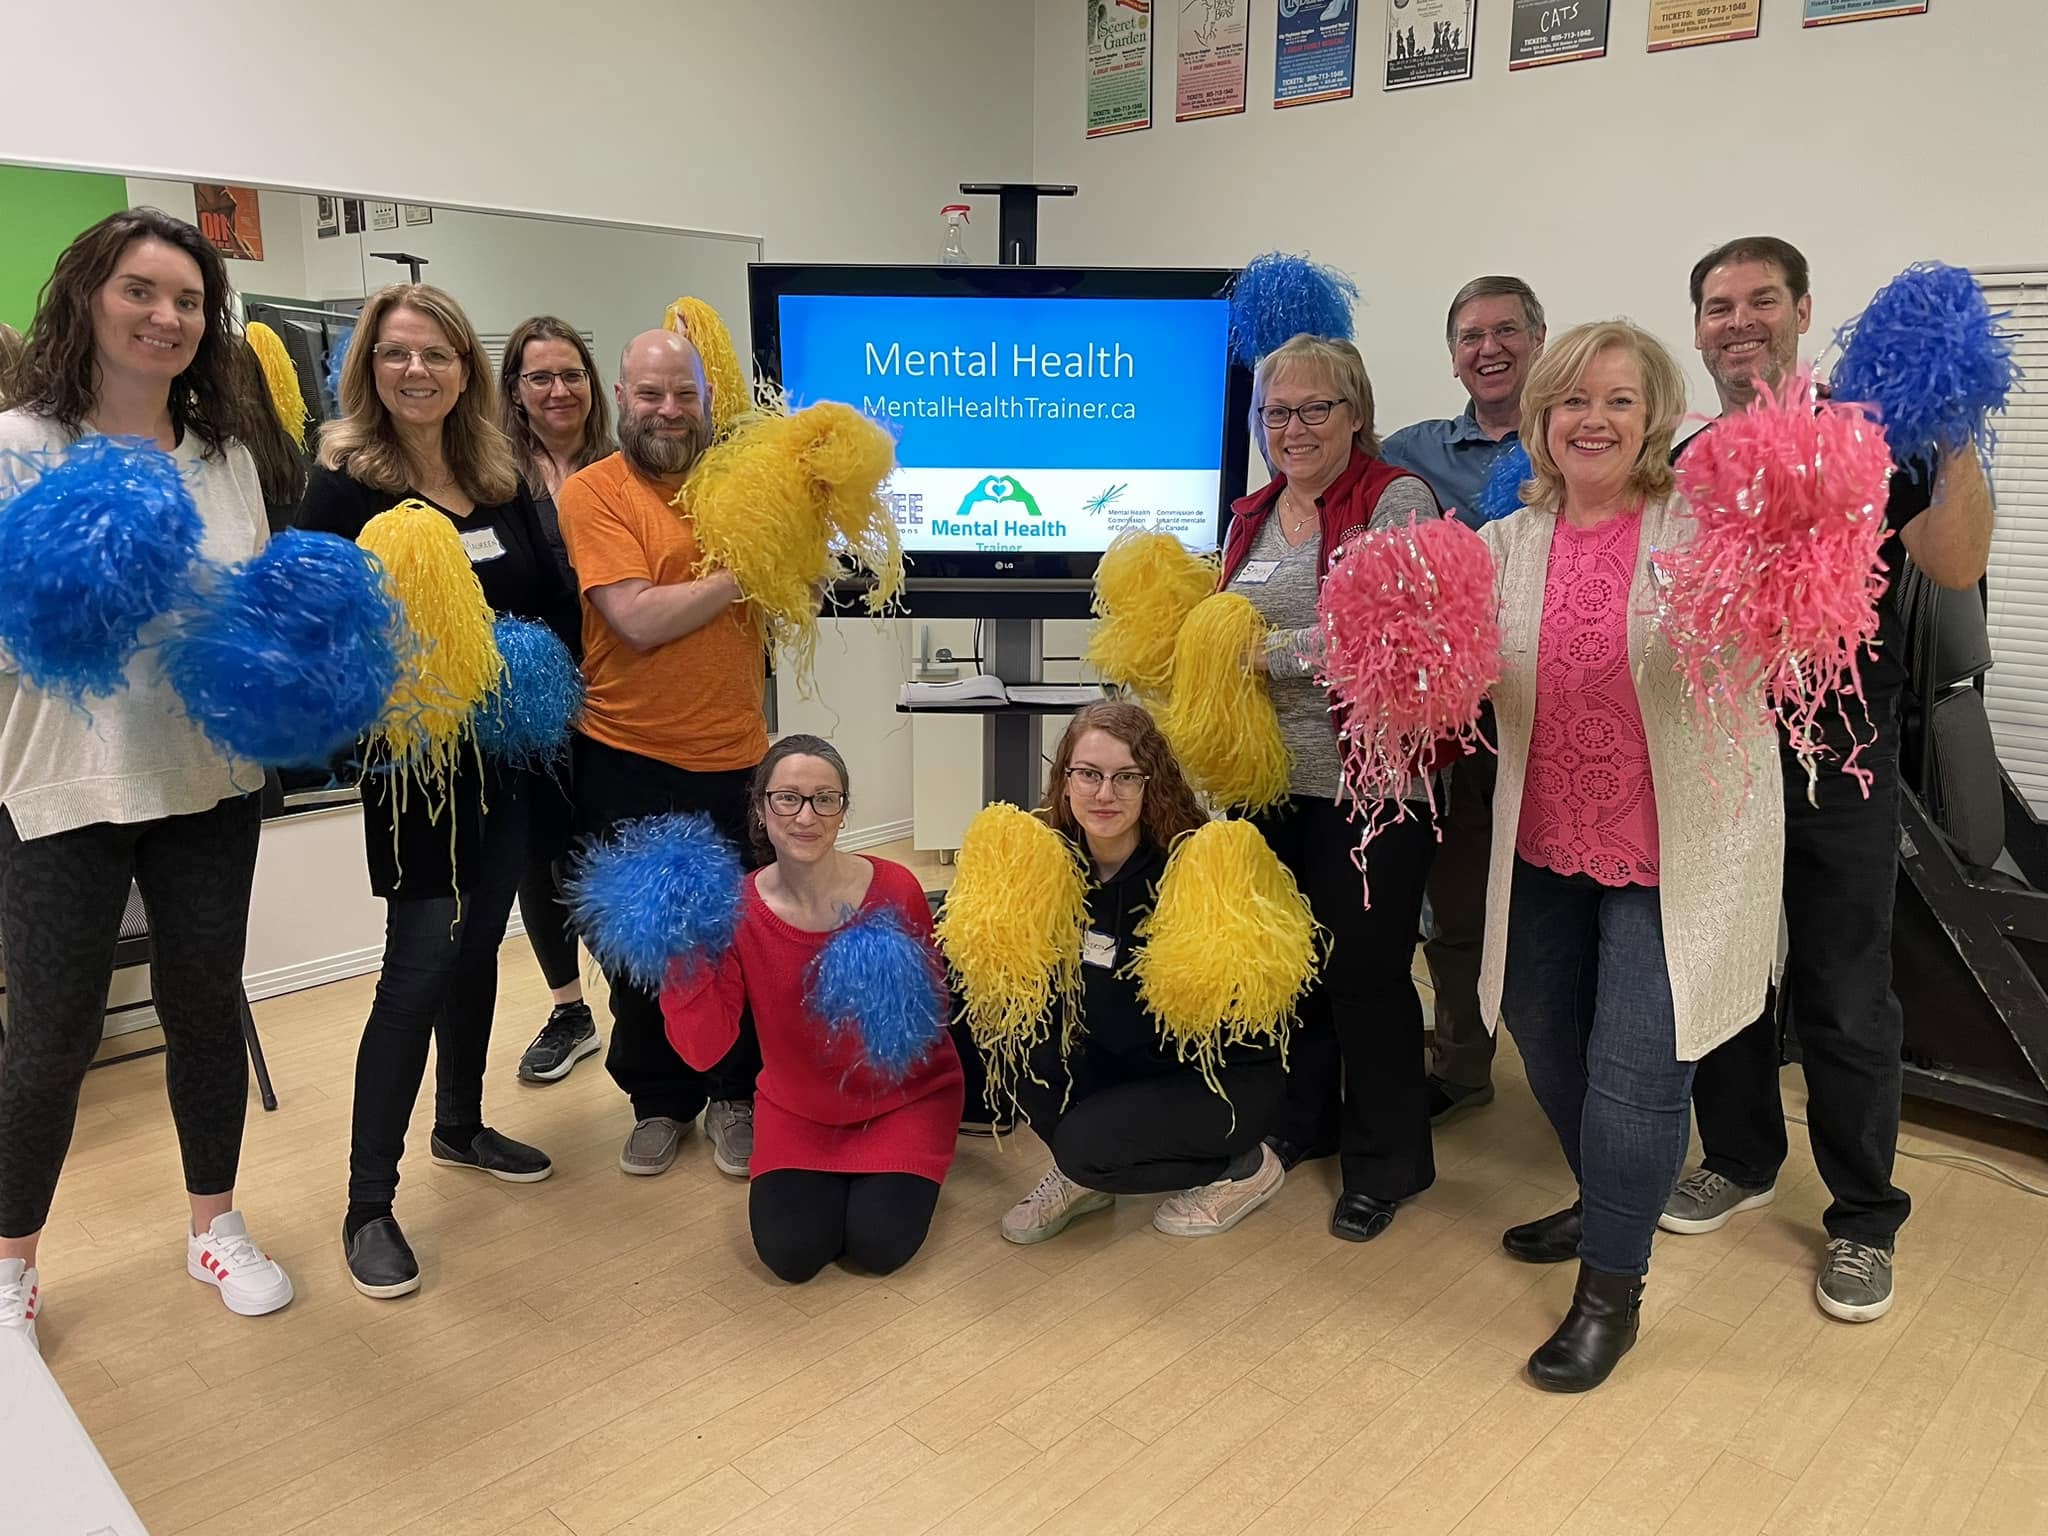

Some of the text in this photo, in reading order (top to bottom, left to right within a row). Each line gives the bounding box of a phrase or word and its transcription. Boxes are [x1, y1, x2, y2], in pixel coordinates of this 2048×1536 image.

[1540, 1, 1580, 32] CATS
[1661, 10, 1693, 22] TICKETS:
[1100, 17, 1136, 38] Secret
[1103, 31, 1147, 50] Garden
[865, 341, 1135, 378] Mental Health
[863, 395, 1136, 420] MentalHealthTrainer.ca
[931, 519, 1067, 537] Mental Health
[976, 542, 1022, 552] Trainer
